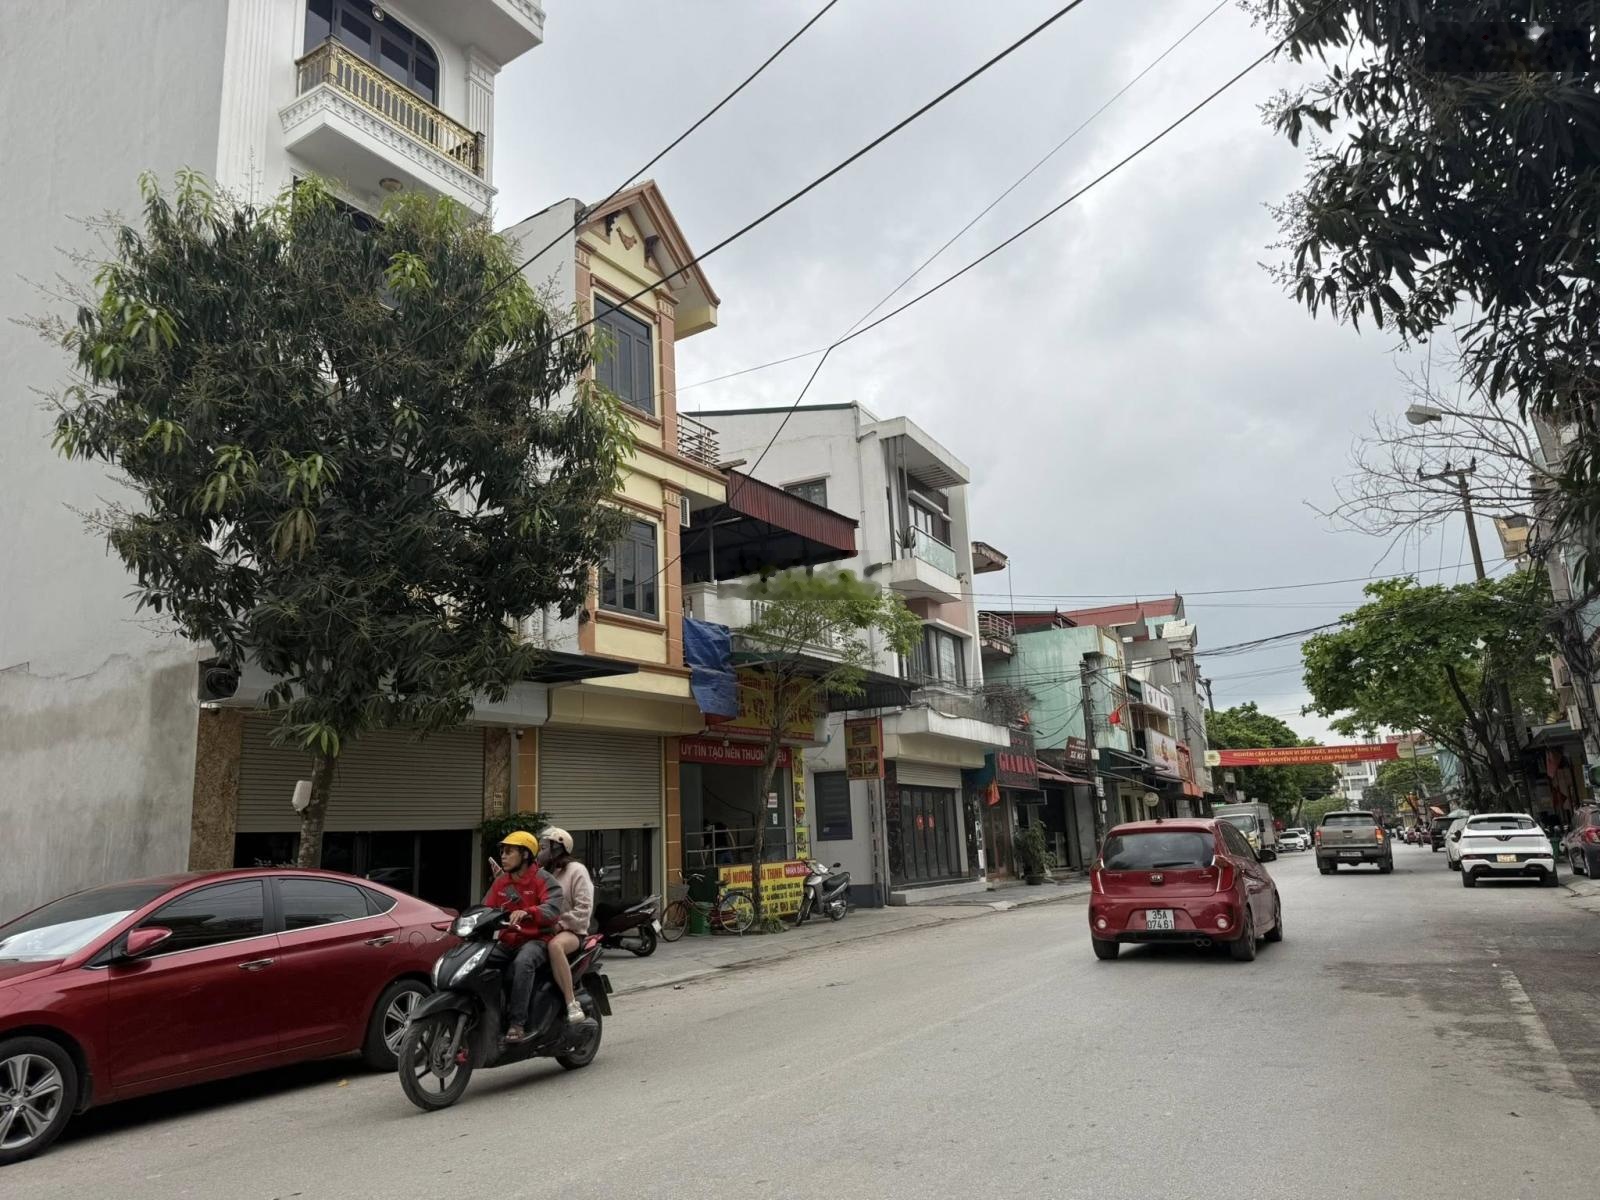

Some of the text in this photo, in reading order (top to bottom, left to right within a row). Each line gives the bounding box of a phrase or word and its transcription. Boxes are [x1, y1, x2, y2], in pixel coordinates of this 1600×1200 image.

[681, 743, 692, 755] UY
[693, 743, 707, 756] TÍN
[708, 745, 723, 760] TẠO
[1152, 910, 1168, 920] 35A
